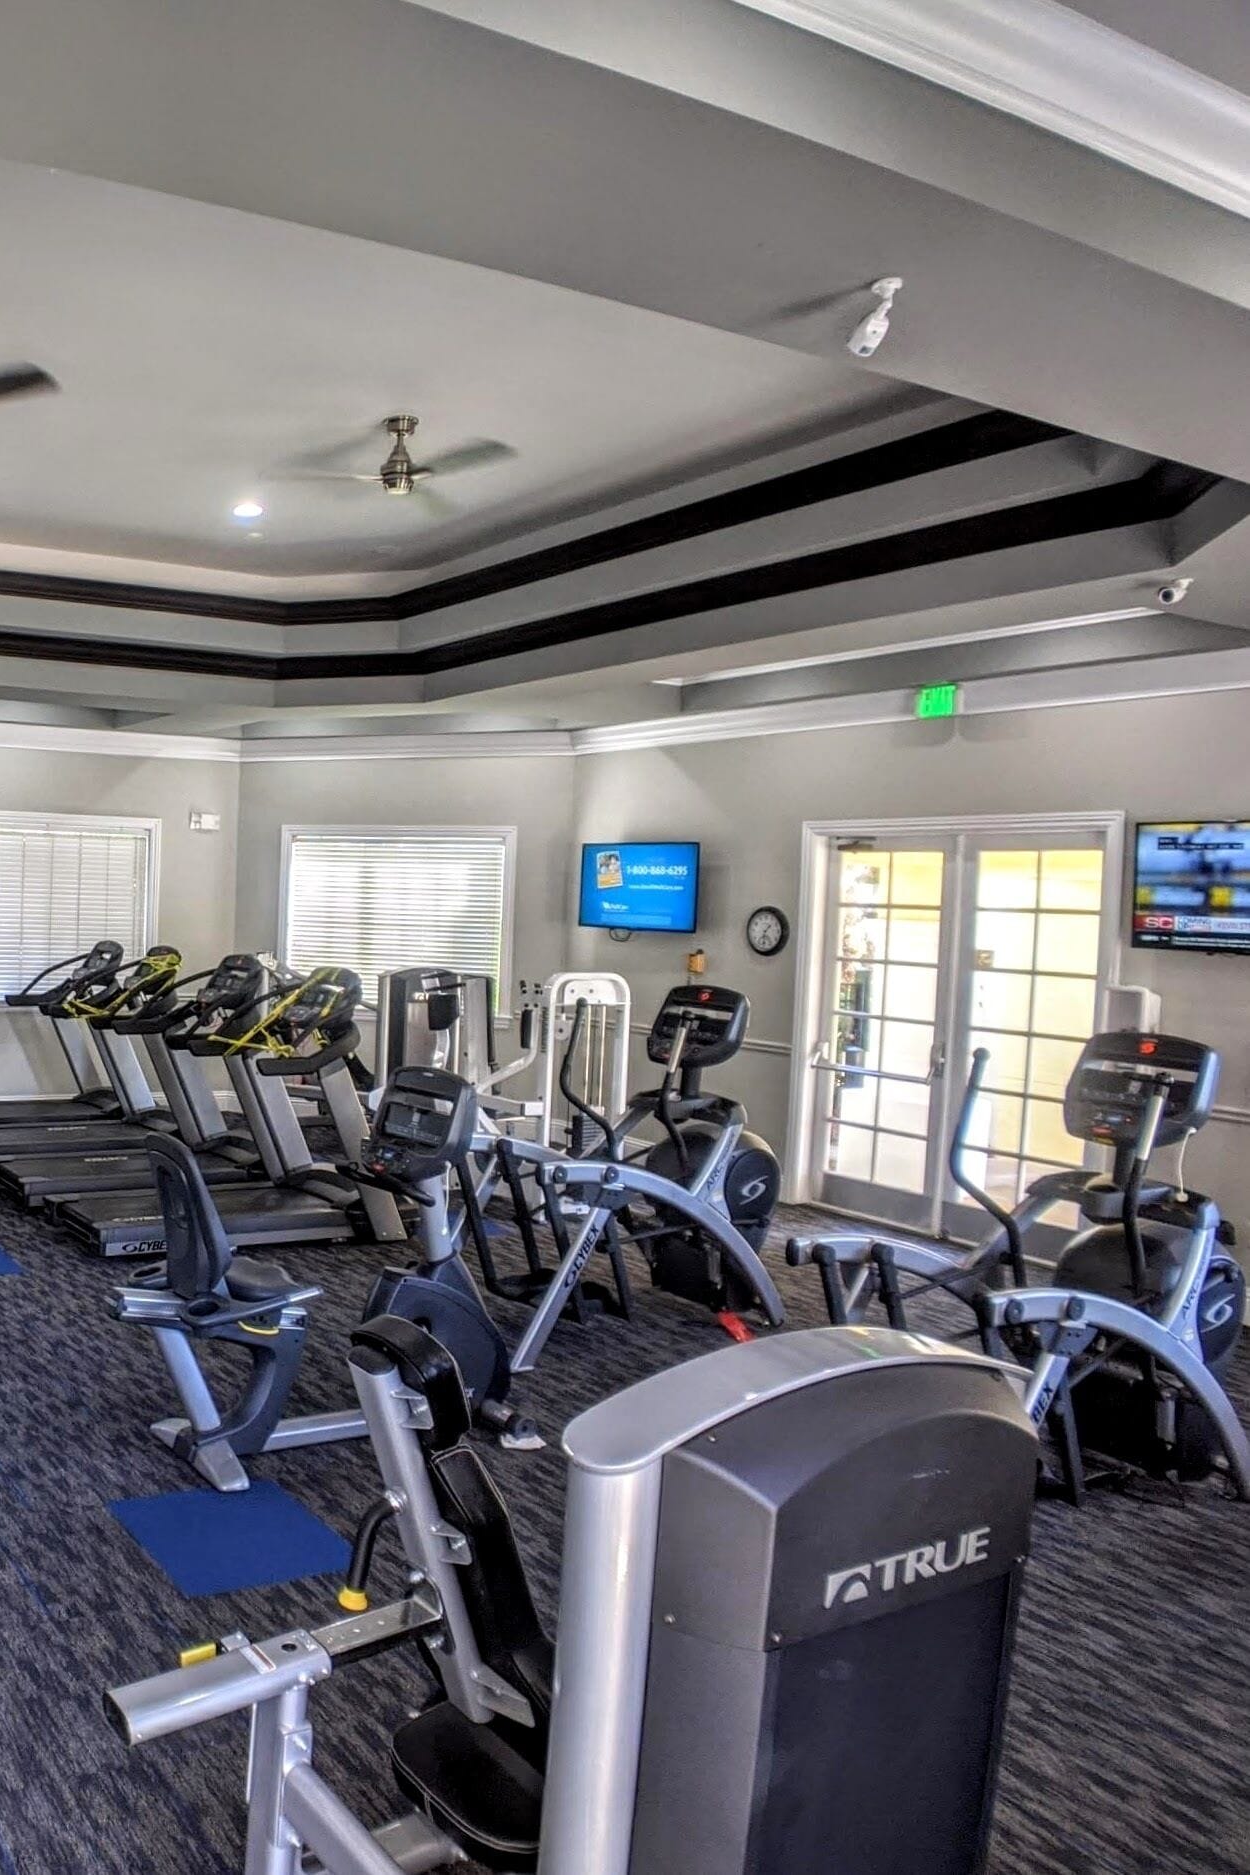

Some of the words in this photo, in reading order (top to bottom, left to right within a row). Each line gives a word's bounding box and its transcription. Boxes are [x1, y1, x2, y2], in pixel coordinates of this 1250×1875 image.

[1145, 916, 1173, 929] SC
[138, 1241, 167, 1253] CYBE
[574, 1223, 599, 1271] CYBEX
[1032, 1382, 1054, 1424] BEX
[875, 1526, 991, 1592] TRUE
